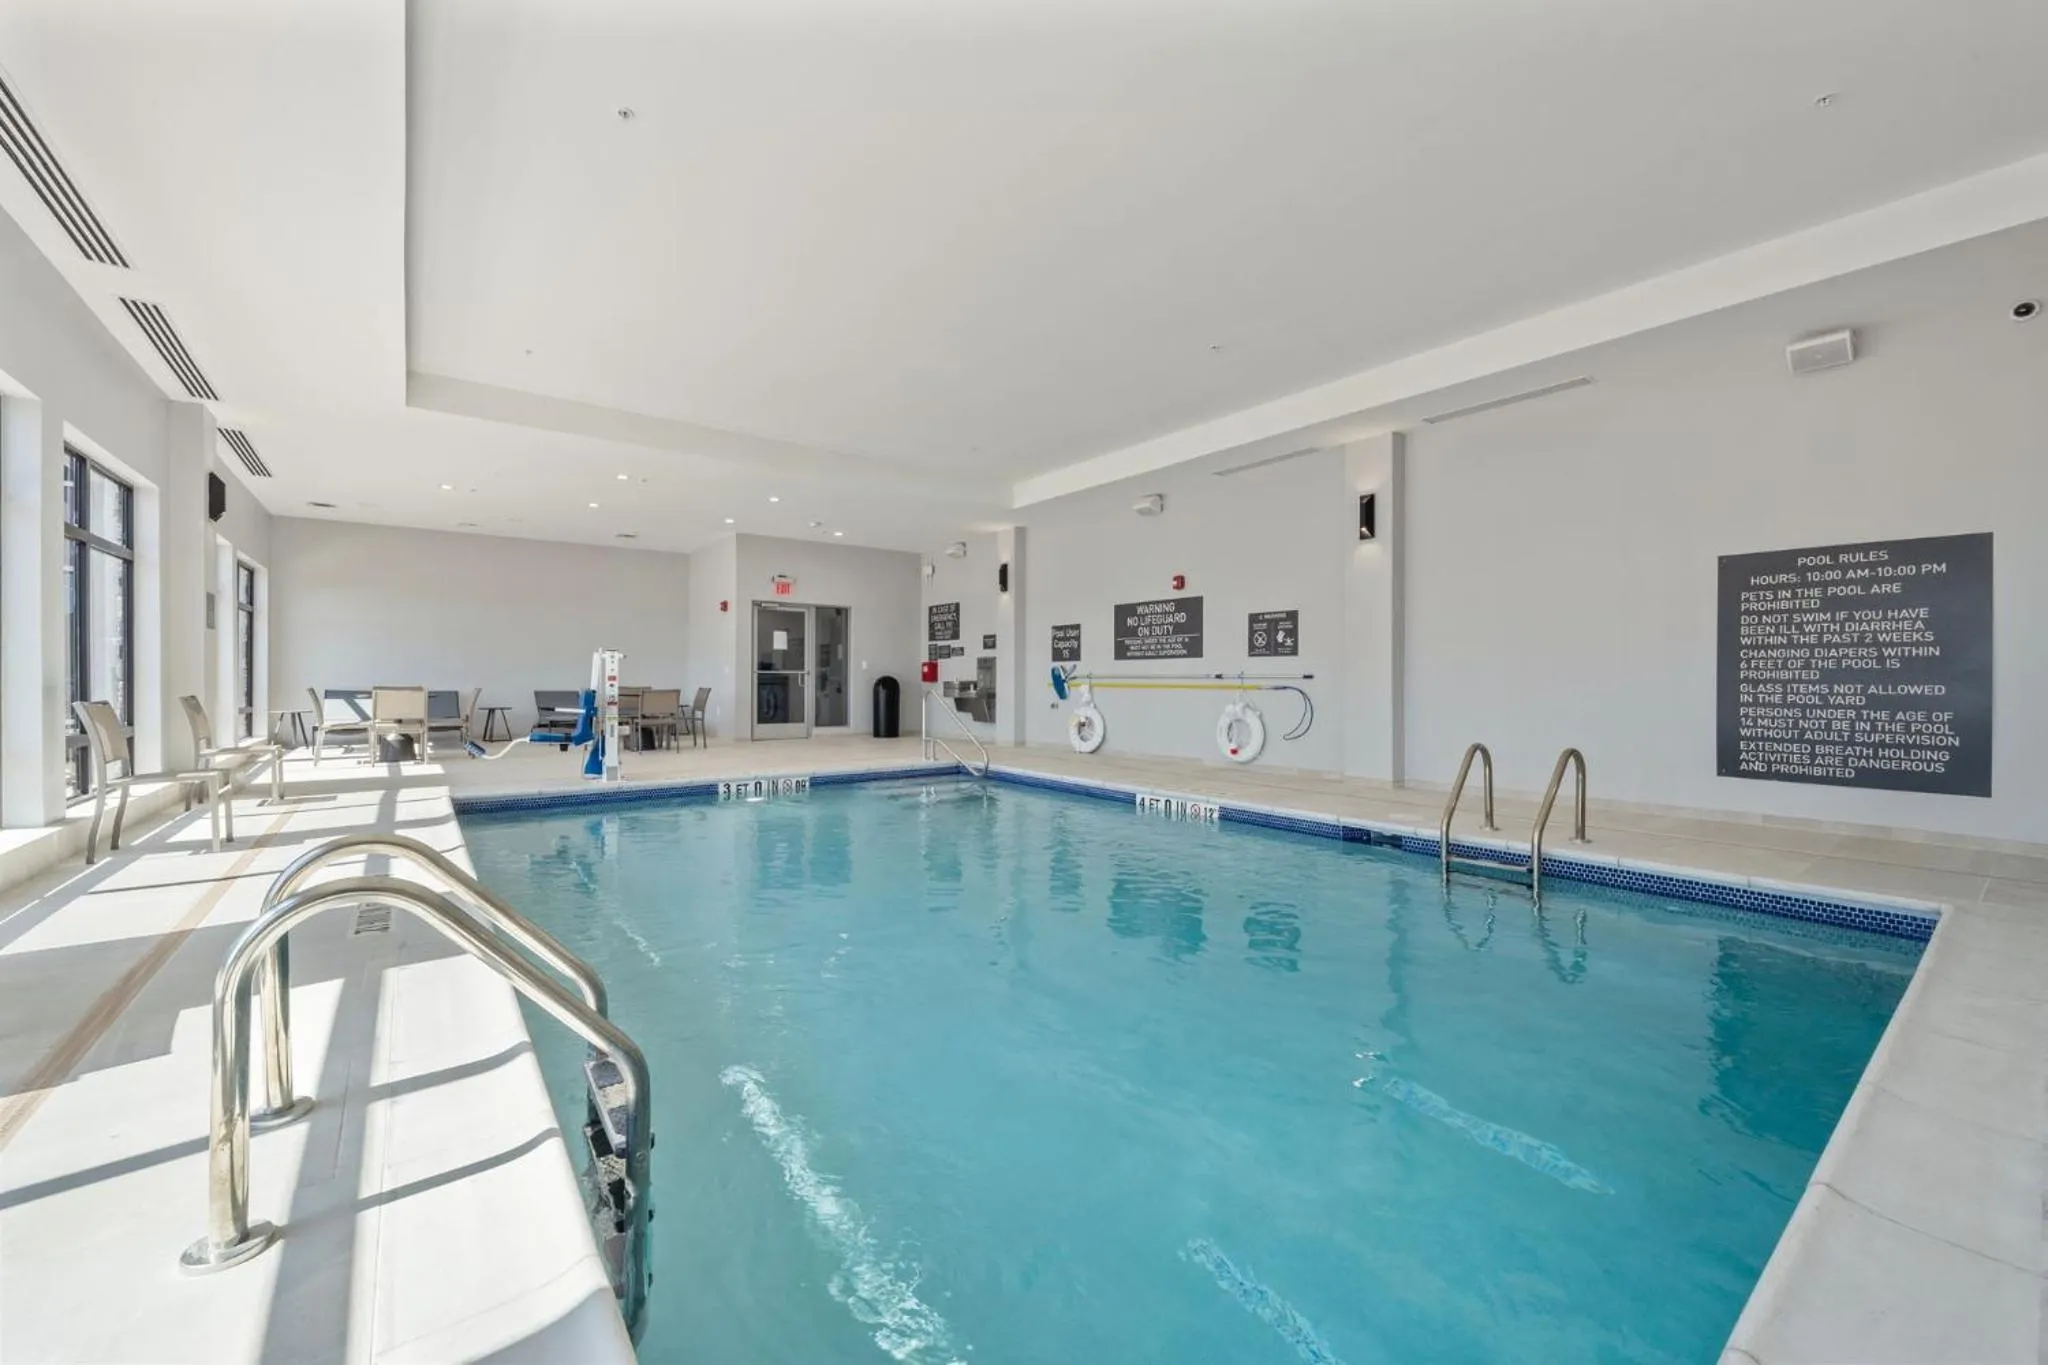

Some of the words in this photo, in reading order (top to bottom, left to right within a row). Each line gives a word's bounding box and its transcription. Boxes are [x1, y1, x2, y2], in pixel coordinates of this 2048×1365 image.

[1797, 554, 1834, 567] POOL
[1839, 550, 1889, 563] RULES
[1750, 573, 1801, 586] HOURS:
[1806, 570, 1842, 581] 10:00
[1845, 565, 1916, 580] AM-10:00
[1921, 562, 1947, 575] PM
[1740, 590, 1774, 601] PETS
[1777, 589, 1792, 599] IN
[1795, 587, 1823, 598] THE
[1827, 585, 1866, 596] POOL
[1870, 582, 1902, 594] ARE
[1136, 602, 1175, 615] WARNING
[1740, 599, 1821, 612] PROHIBITED
[1127, 616, 1139, 627] NO
[1140, 612, 1187, 626] LIFEGUARD
[1740, 615, 1759, 625] DO
[1762, 614, 1789, 624] NOT
[1792, 612, 1831, 623] SWIM
[1835, 611, 1849, 621] IF
[1853, 609, 1882, 620] YOU
[1887, 607, 1929, 619] HAVE
[1137, 627, 1150, 637] ON
[1151, 625, 1174, 636] DUTY
[1740, 625, 1775, 635] BEEN
[1779, 624, 1800, 634] ILL
[1803, 622, 1840, 633] WITH
[1845, 620, 1925, 632] DIARRHEA
[1739, 635, 1787, 645] WITHIN
[1791, 634, 1819, 644] THE
[1823, 632, 1860, 644] PAST
[1864, 632, 1873, 643] 2
[1877, 631, 1935, 642] WEEKS
[1740, 648, 1810, 659] CHANGING
[1814, 647, 1878, 658] DIAPERS
[1882, 646, 1940, 657] WITHIN
[1740, 659, 1748, 669] 6
[1751, 659, 1783, 669] FEET
[1787, 659, 1806, 668] OF
[1810, 659, 1838, 669] THE
[1841, 659, 1881, 669] POOL
[1886, 659, 1901, 668] IS
[1740, 669, 1820, 680] PROHIBITED
[1740, 683, 1783, 693] GLASS
[1787, 684, 1829, 694] ITEMS
[1833, 684, 1864, 694] NOT
[1867, 684, 1946, 695] ALLOWED
[1740, 694, 1753, 703] IN
[1757, 694, 1783, 704] THE
[1787, 695, 1823, 704] POOL
[1827, 695, 1866, 706] YARD
[1740, 706, 1802, 718] PERSONS
[1806, 708, 1856, 719] UNDER
[1861, 709, 1891, 721] THE
[1895, 710, 1928, 722] AGE
[1932, 711, 1954, 722] OF
[1741, 717, 1754, 726] 14
[1757, 718, 1794, 728] MUST
[1799, 719, 1827, 730] NOT
[1831, 720, 1851, 731] BE
[1855, 721, 1870, 731] IN
[1875, 721, 1907, 733] THE
[1910, 723, 1955, 735] POOL
[1739, 728, 1800, 739] WITHOUT
[1804, 730, 1850, 741] ADULT
[1855, 732, 1960, 747] SUPERVISION
[1740, 740, 1812, 753] EXTENDED
[1815, 744, 1873, 757] BREATH
[1878, 747, 1950, 761] HOLDING
[1740, 752, 1811, 764] ACTIVITIES
[1814, 756, 1844, 766] ARE
[1848, 757, 1945, 773] DANGEROUS
[1740, 761, 1768, 772] AND
[1771, 763, 1855, 778] PROHIBITED
